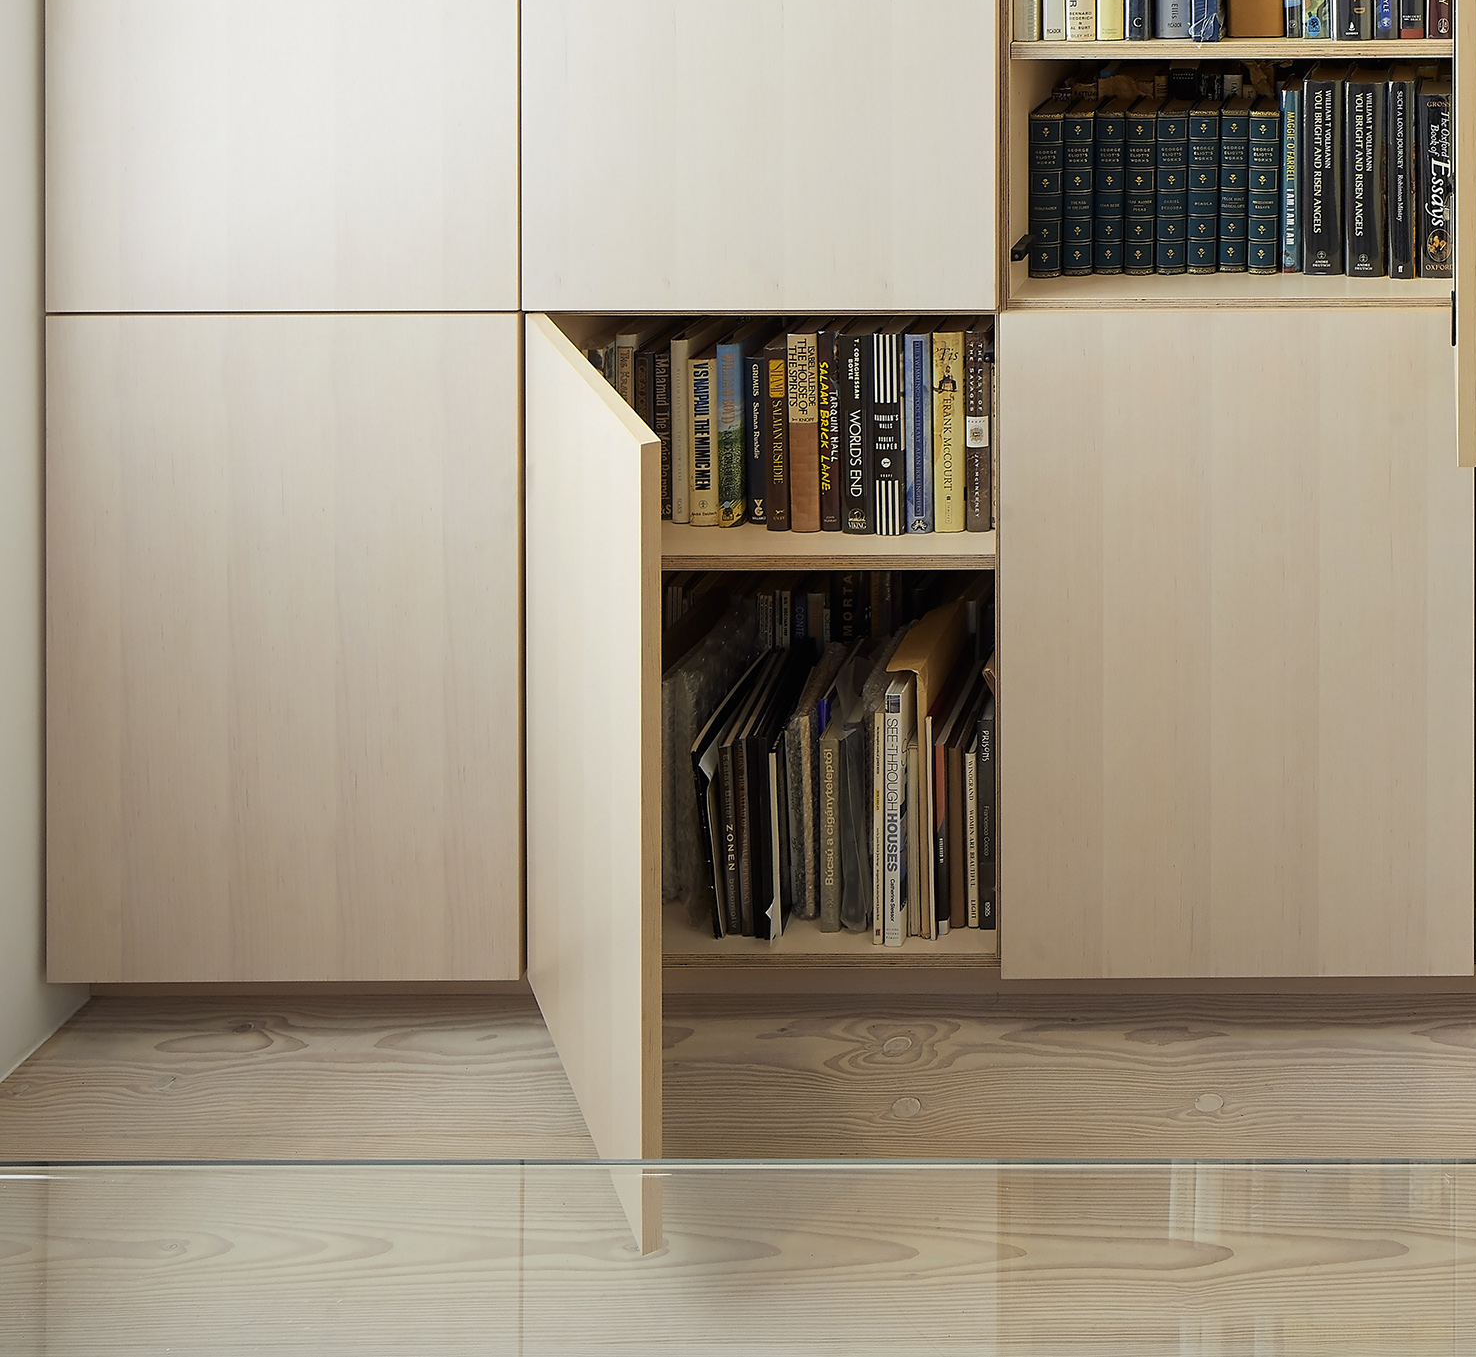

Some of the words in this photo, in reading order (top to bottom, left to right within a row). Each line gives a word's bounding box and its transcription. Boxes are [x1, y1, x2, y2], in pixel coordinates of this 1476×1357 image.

[1354, 93, 1364, 112] YOU
[1286, 112, 1294, 140] MAGGIE
[1354, 114, 1364, 148] BRIGHT
[1430, 124, 1438, 144] Book
[1440, 112, 1450, 128] The
[1428, 146, 1439, 157] of
[1440, 128, 1450, 157] Oxford
[1286, 142, 1294, 182] O'FARRELL
[1354, 150, 1364, 171] AND
[1354, 174, 1364, 200] RISEN
[1424, 158, 1451, 227] Essays
[1354, 201, 1364, 237] ANGELS
[694, 378, 710, 418] NAIPAUL
[820, 361, 830, 406] SALAAM
[694, 418, 710, 436] THE
[773, 400, 784, 440] SALMAN
[830, 390, 839, 432] TARQUIN
[943, 398, 952, 433] FRANK
[820, 408, 830, 450] BRICK
[849, 410, 862, 466] WORLD'S
[694, 437, 710, 468] MIMIC
[773, 442, 784, 484] RUSHDIE
[830, 436, 839, 462] HALL
[943, 438, 952, 490] McCOURT
[694, 470, 710, 490] MEN
[849, 470, 862, 498] END
[981, 730, 991, 762] PRISONS
[886, 718, 898, 811] SEE-THROUGH
[726, 822, 736, 871] ZONEN
[886, 812, 898, 872] HOUSES
